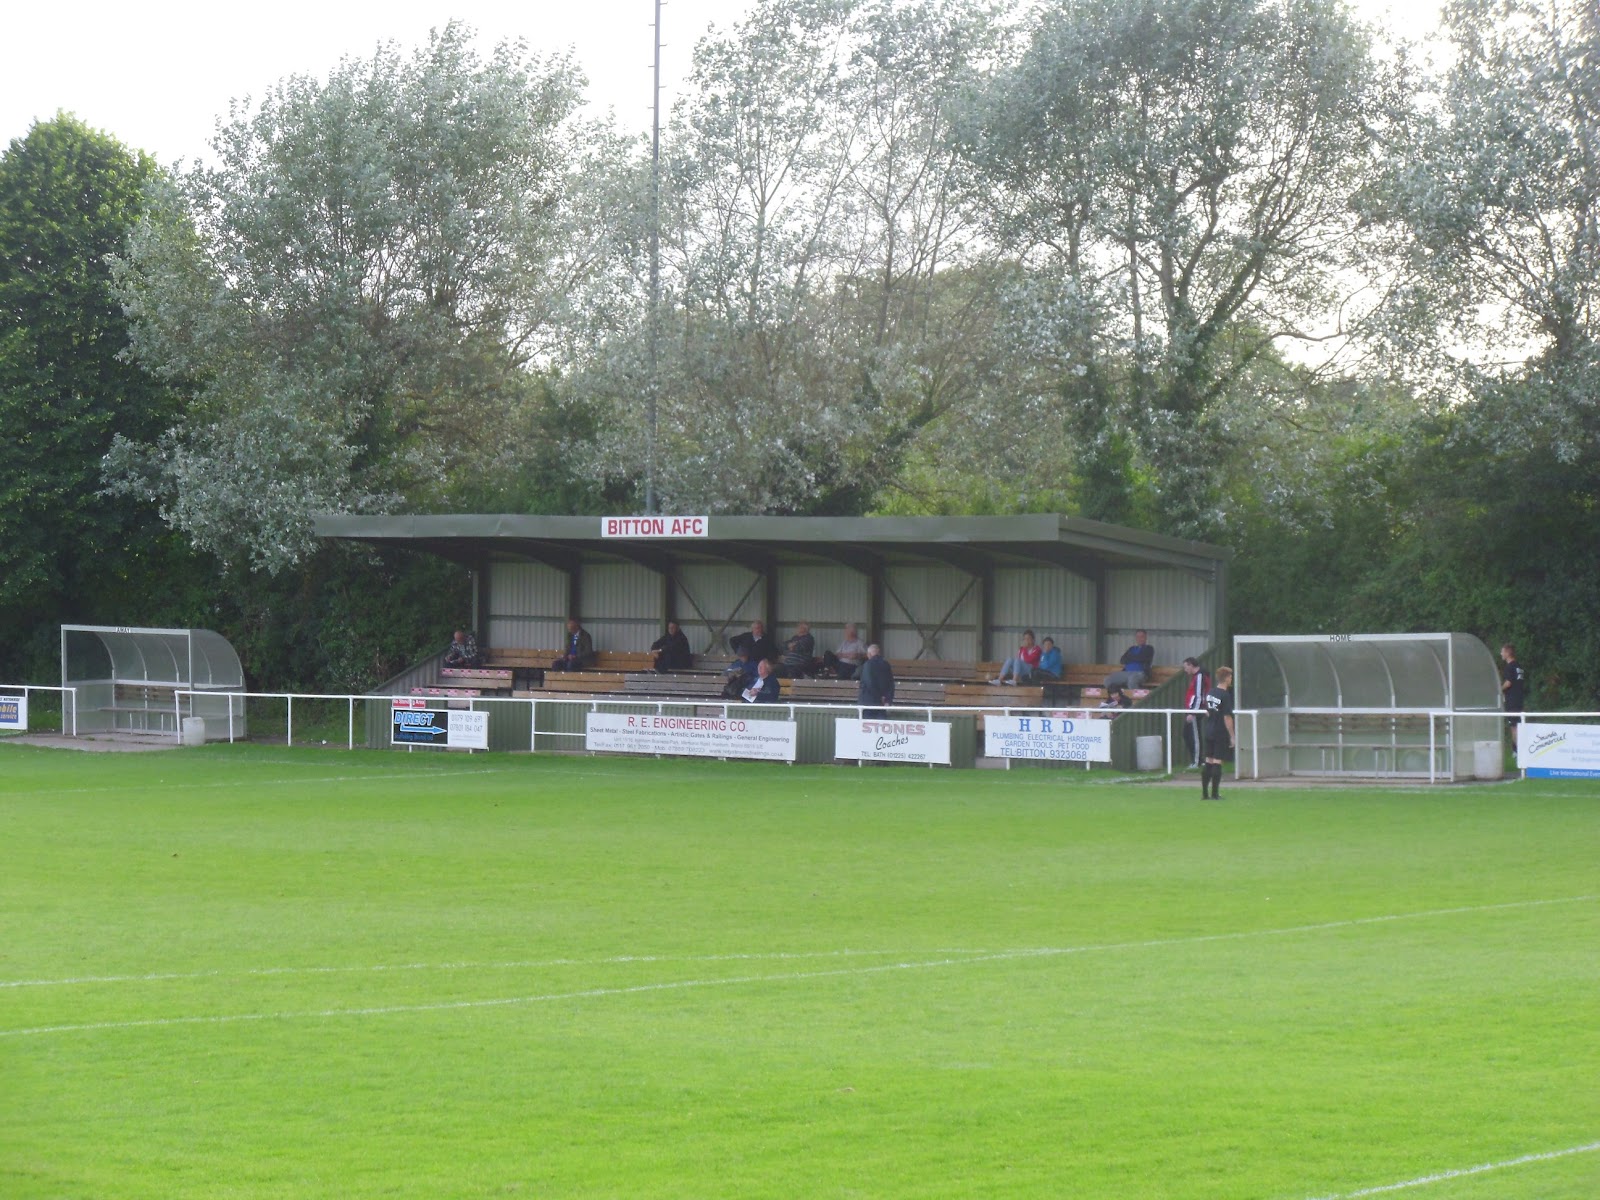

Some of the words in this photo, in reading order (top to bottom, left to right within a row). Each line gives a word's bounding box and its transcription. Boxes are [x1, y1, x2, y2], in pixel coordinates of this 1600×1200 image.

[607, 519, 664, 535] BITTON
[671, 519, 703, 534] AFC
[394, 711, 436, 726] DIRECT
[627, 716, 638, 727] R.
[641, 717, 651, 728] E.
[653, 718, 727, 731] ENGINEERING
[730, 721, 749, 733] CO.
[861, 722, 926, 736] STONES
[1019, 718, 1031, 732] H
[1041, 719, 1052, 733] R
[1062, 720, 1074, 734] D
[875, 733, 909, 750] Coaches
[992, 732, 1024, 740] PLUMBING
[1028, 734, 1065, 742] ELECTRICAL
[1068, 736, 1102, 744] HARDWARE
[1005, 740, 1030, 748] GARDEN
[1058, 742, 1069, 750] PET
[887, 751, 906, 759] (01225)
[1050, 749, 1087, 759] 9323068
